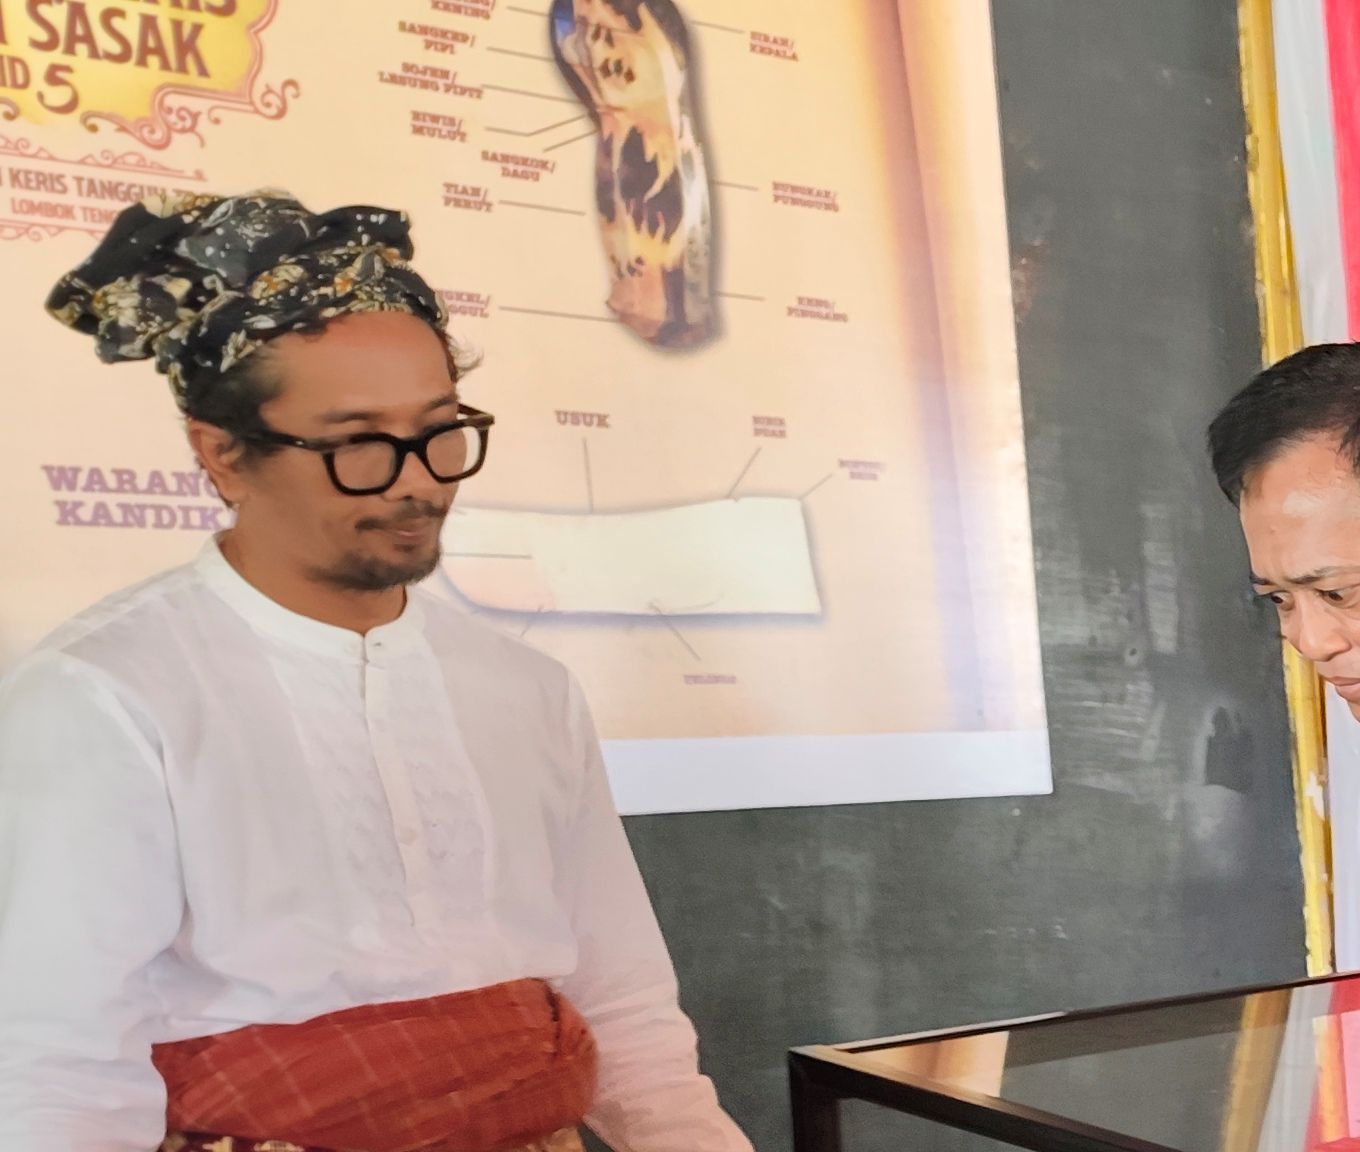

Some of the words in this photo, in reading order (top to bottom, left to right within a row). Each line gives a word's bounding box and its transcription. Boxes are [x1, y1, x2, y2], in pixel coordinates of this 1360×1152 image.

[26, 0, 210, 78] SASAK
[37, 62, 79, 115] 5
[8, 167, 68, 194] KERIS
[501, 166, 540, 182] DAGU
[10, 197, 75, 220] LOMBOK
[443, 196, 494, 213] PERUT
[555, 410, 610, 428] USUK
[54, 500, 224, 531] KANDIK
